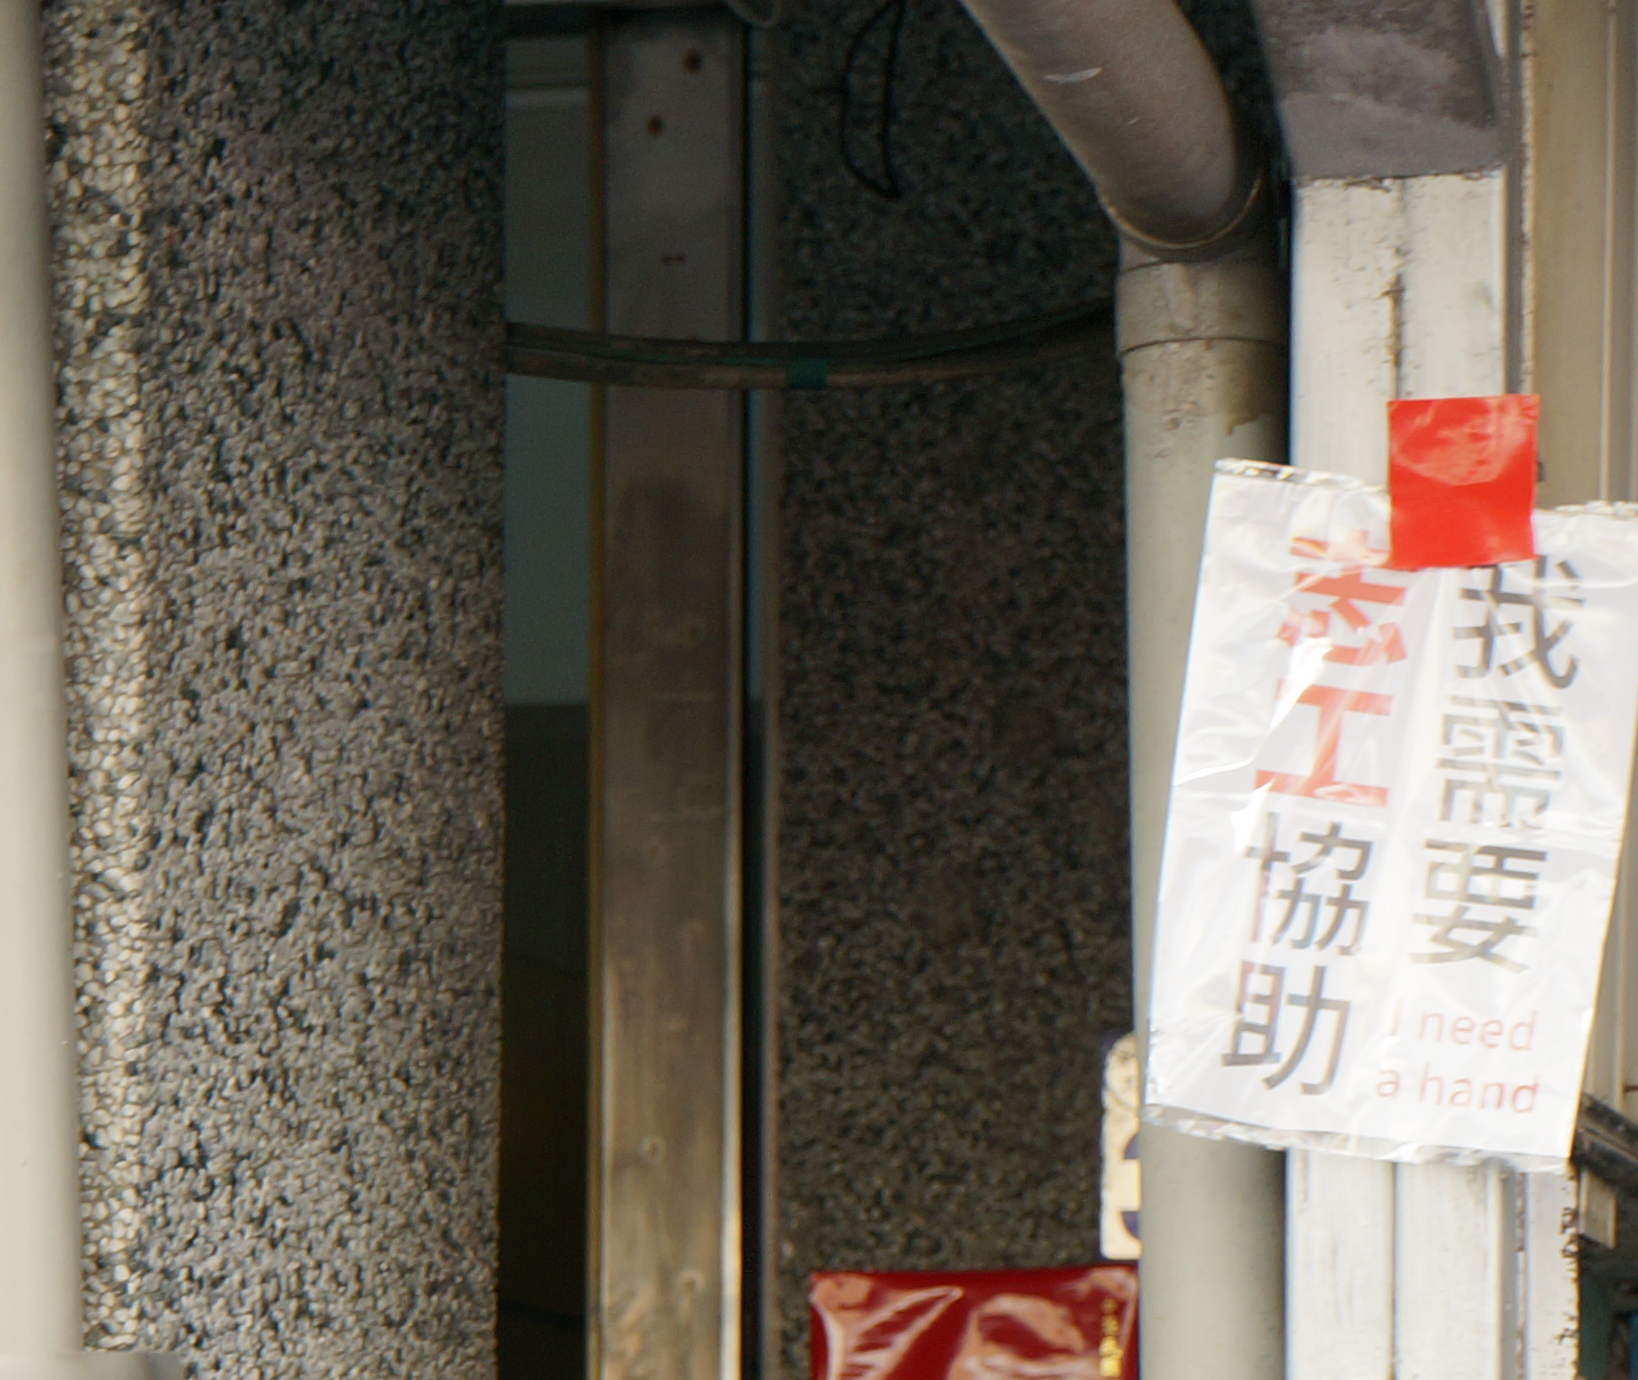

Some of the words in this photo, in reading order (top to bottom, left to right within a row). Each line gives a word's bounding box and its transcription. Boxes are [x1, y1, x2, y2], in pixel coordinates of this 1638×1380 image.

[1410, 552, 1587, 975] 我需要
[1417, 1010, 1539, 1051] need
[1374, 1068, 1401, 1099] a
[1418, 1061, 1540, 1114] hand
